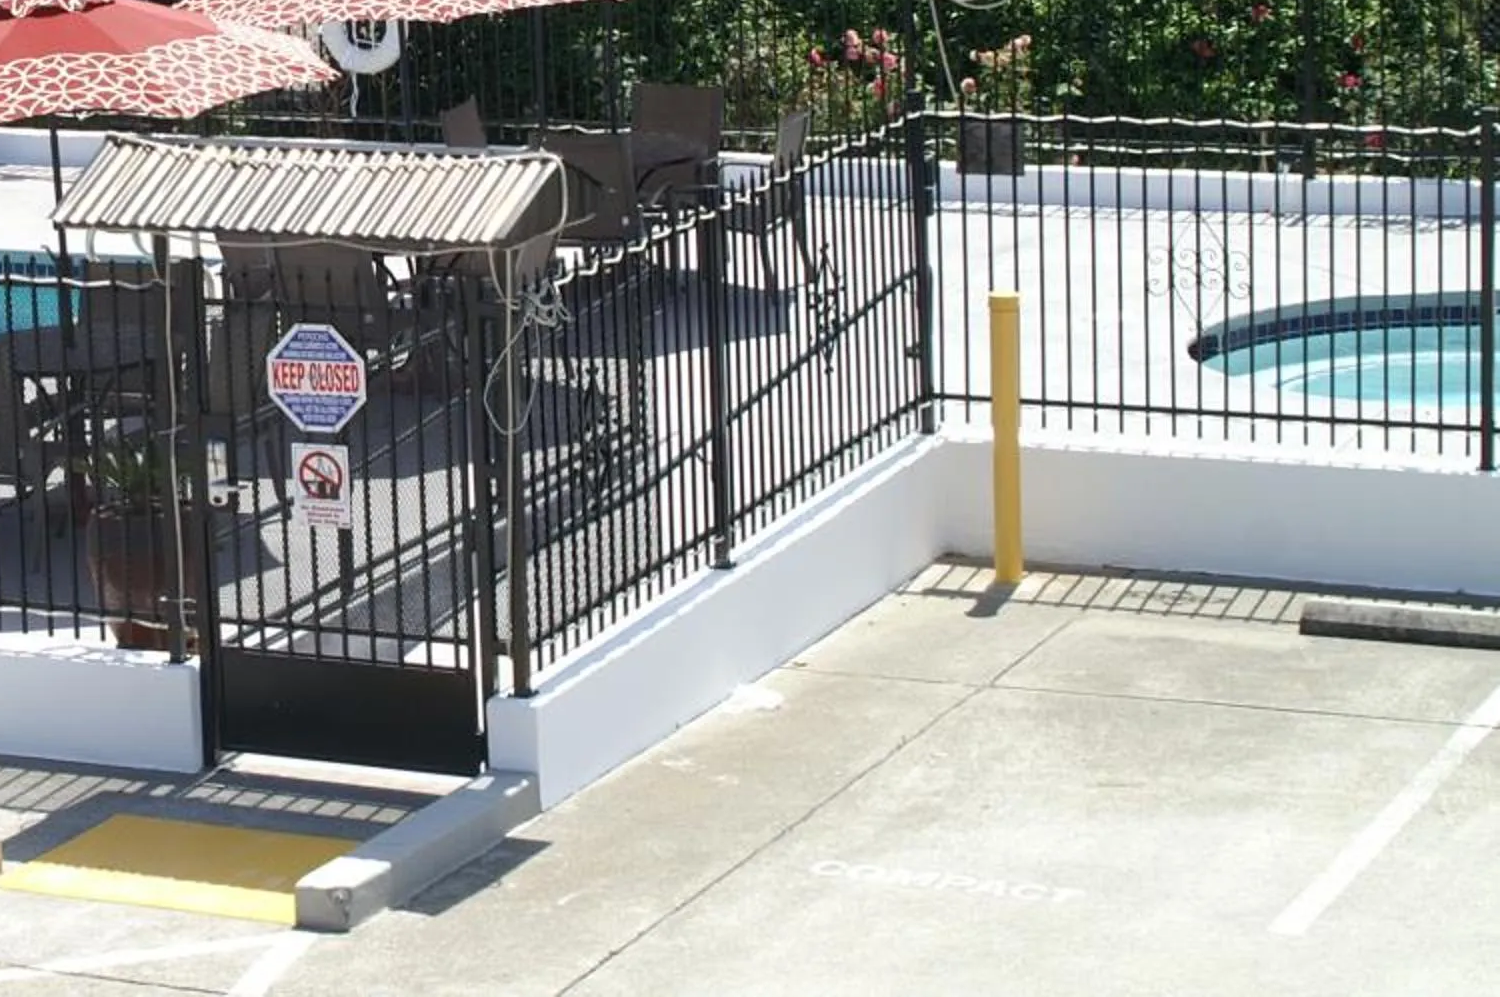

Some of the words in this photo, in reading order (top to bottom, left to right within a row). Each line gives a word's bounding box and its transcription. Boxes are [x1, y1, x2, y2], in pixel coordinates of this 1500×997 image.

[272, 361, 305, 390] KEEP
[309, 363, 359, 393] CLOSED
[809, 860, 1086, 902] COMPACT
